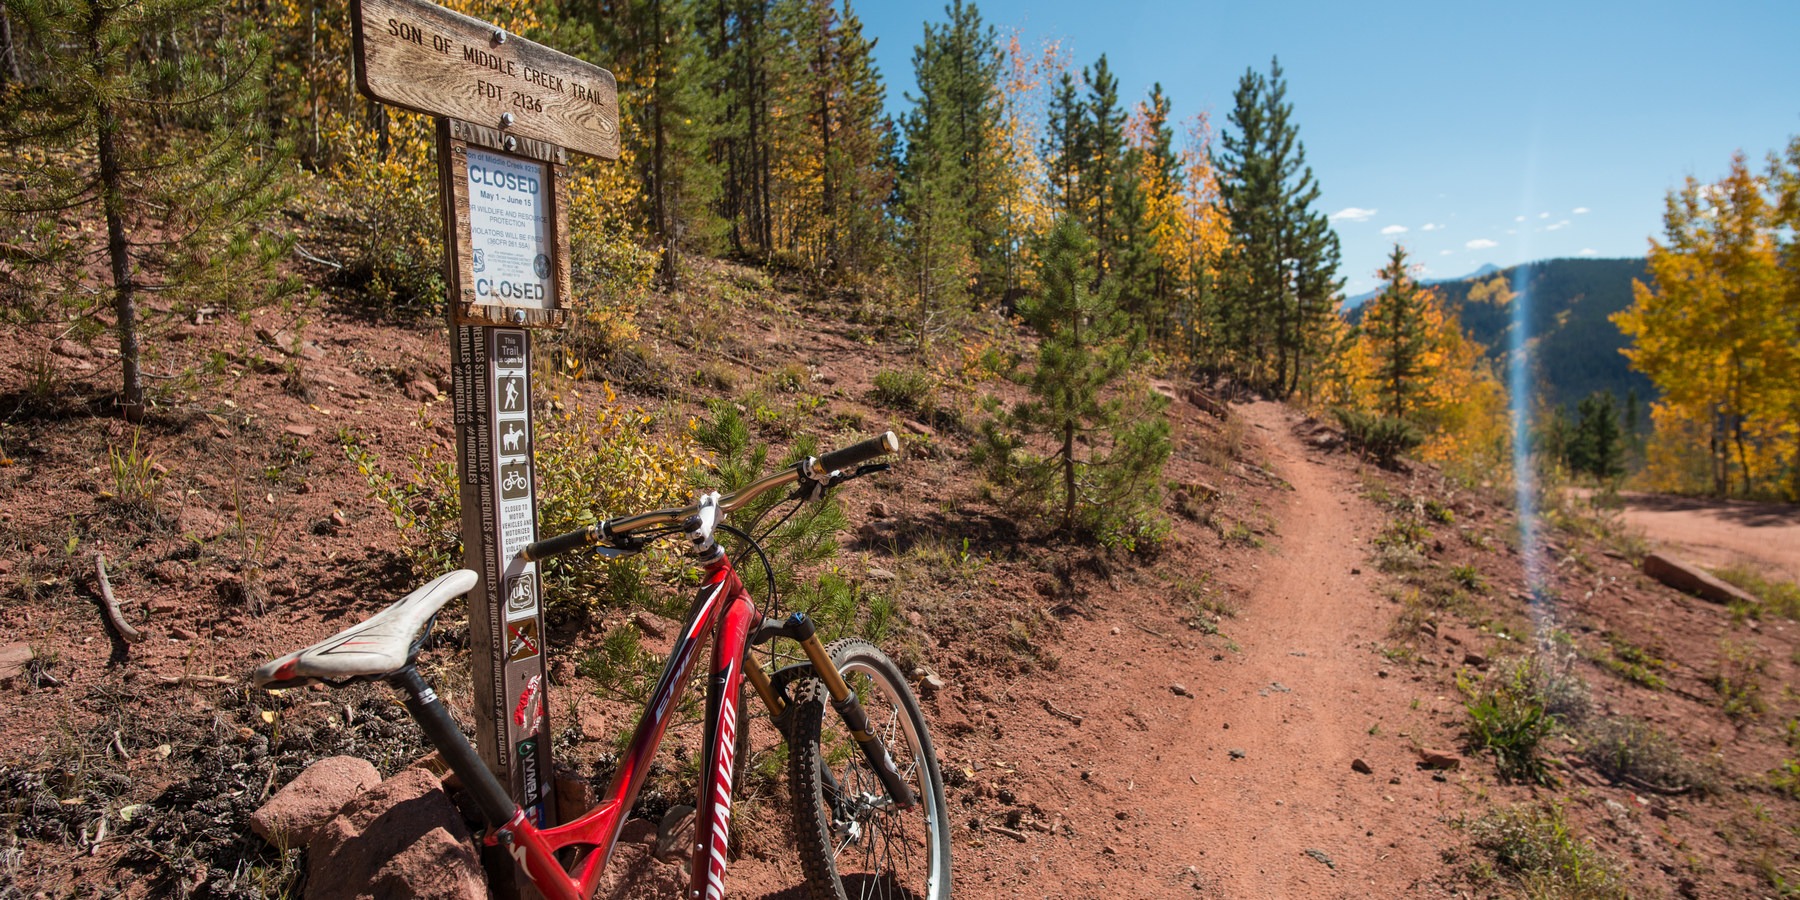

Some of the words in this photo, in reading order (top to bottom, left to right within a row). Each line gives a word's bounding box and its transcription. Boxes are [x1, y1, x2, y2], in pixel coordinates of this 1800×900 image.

[387, 18, 423, 46] SON
[433, 34, 453, 54] OF
[463, 44, 515, 78] MIDDLE
[523, 66, 564, 94] CREEK
[571, 82, 604, 106] TRAIL
[512, 91, 543, 113] 2136
[485, 155, 506, 166] Middle
[506, 160, 524, 171] Creek
[469, 164, 539, 195] CLOSED
[480, 190, 494, 202] May
[496, 193, 500, 201] 1
[507, 195, 523, 206] June
[524, 198, 532, 207] 15
[476, 204, 504, 215] WILDLIFE
[505, 210, 517, 218] AND
[518, 212, 548, 223] RESOURCE
[489, 215, 526, 228] PROTECTION
[505, 231, 519, 240] WILL
[519, 233, 527, 241] BE
[477, 278, 545, 300] CLOSED
[504, 336, 516, 345] This
[502, 345, 519, 356] Trail
[454, 365, 467, 424] #MOREDALES
[477, 414, 490, 473] #MOREDALES
[467, 425, 478, 484] #MOREDALES
[480, 474, 494, 532] #MOREDALES
[505, 505, 521, 513] CLOSED
[509, 512, 524, 520] MOTOR
[502, 520, 523, 530] VEHICLES
[505, 527, 530, 537] MOTORIZED
[506, 535, 530, 546] EQUIPMENT
[484, 533, 497, 591] #MOREDALES
